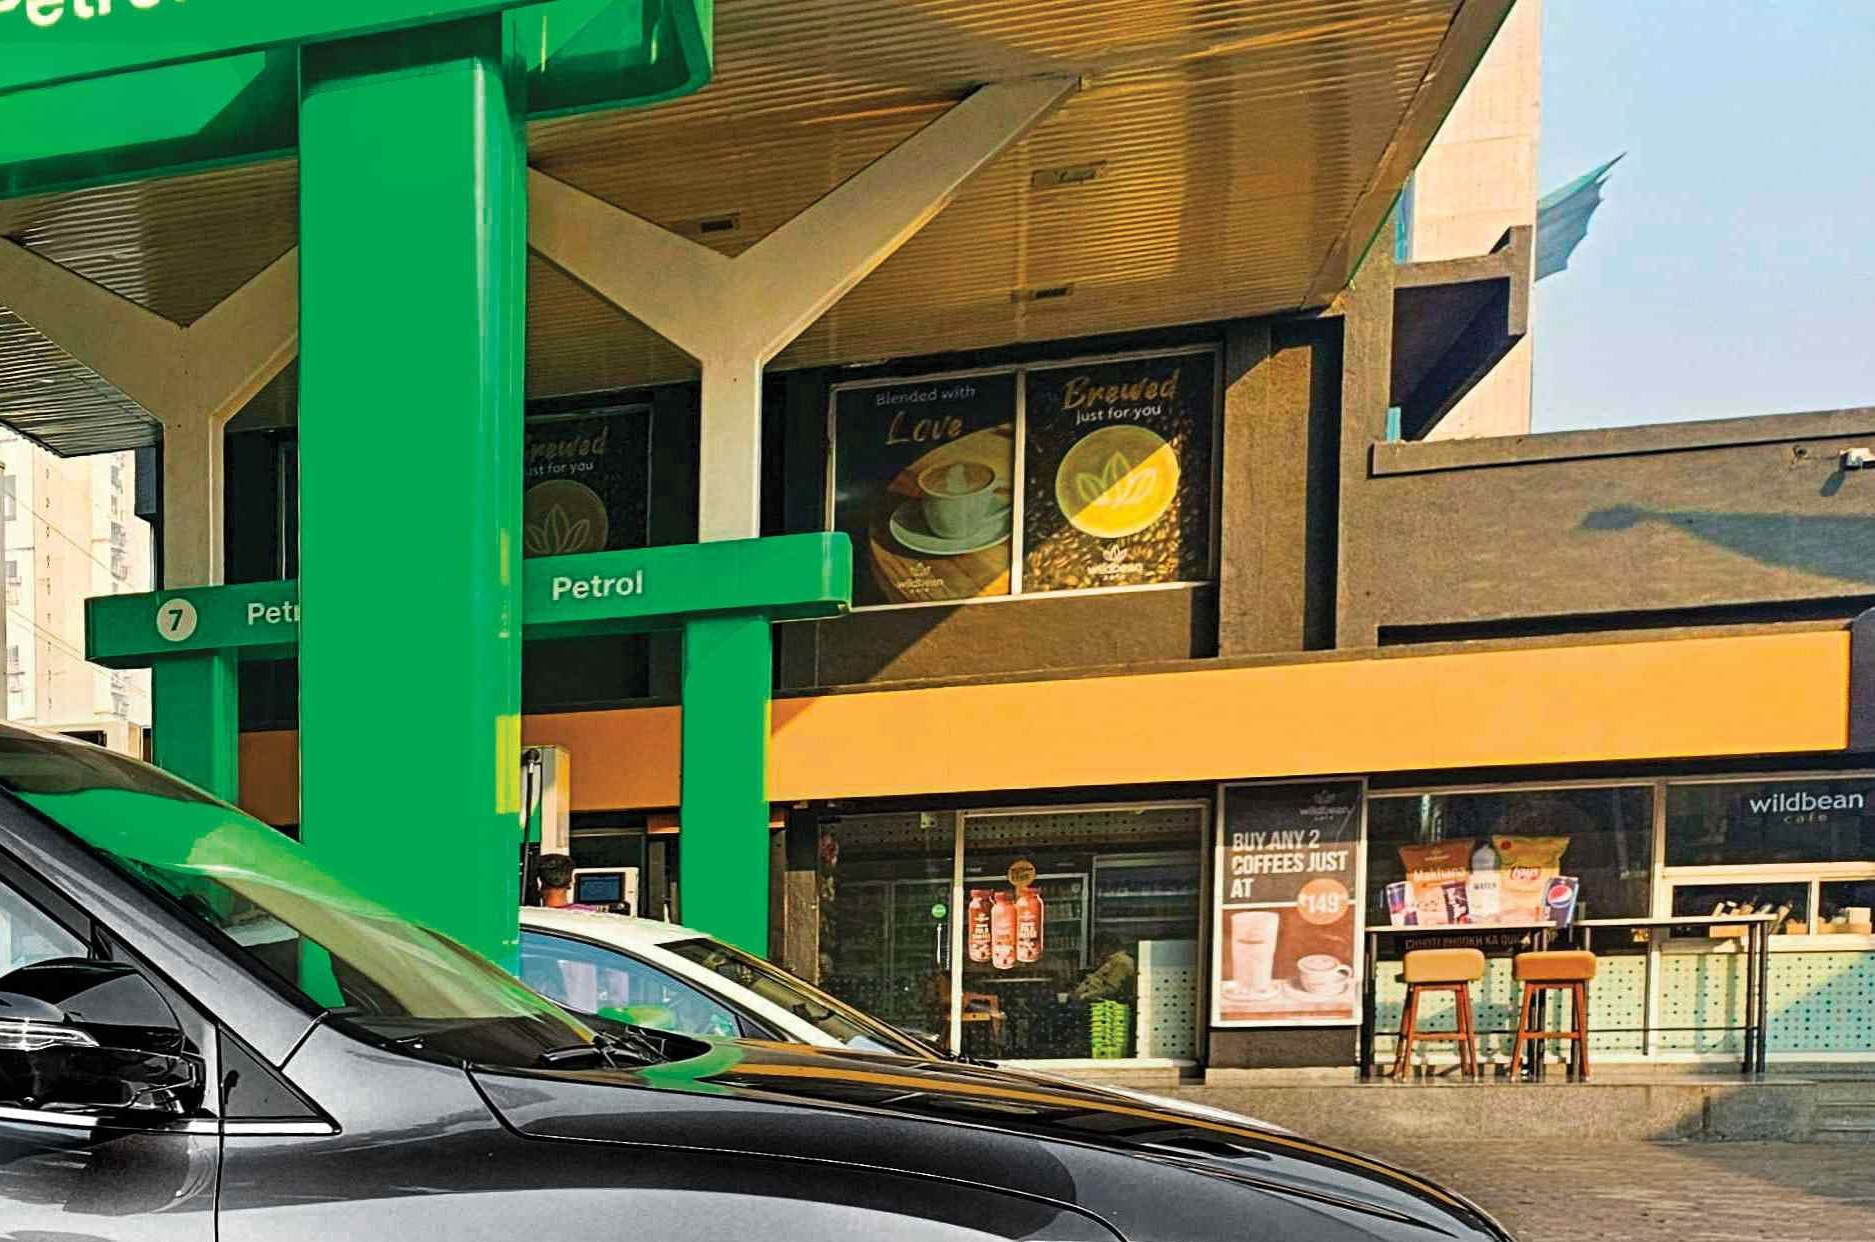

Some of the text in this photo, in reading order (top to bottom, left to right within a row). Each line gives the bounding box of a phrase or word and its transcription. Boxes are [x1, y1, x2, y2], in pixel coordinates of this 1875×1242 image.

[876, 385, 975, 406] Blended with
[1062, 368, 1180, 410] Brewed
[1108, 406, 1130, 419] for
[1133, 405, 1161, 420] you
[886, 410, 962, 445] Love
[552, 570, 643, 601] Petrol
[168, 609, 183, 631] 7
[1749, 791, 1863, 813] wildbean
[1783, 813, 1827, 824] cafe
[1232, 829, 1320, 852] BUY ANY 2
[1232, 850, 1349, 875] COFFEES JUST
[1230, 878, 1254, 898] AT
